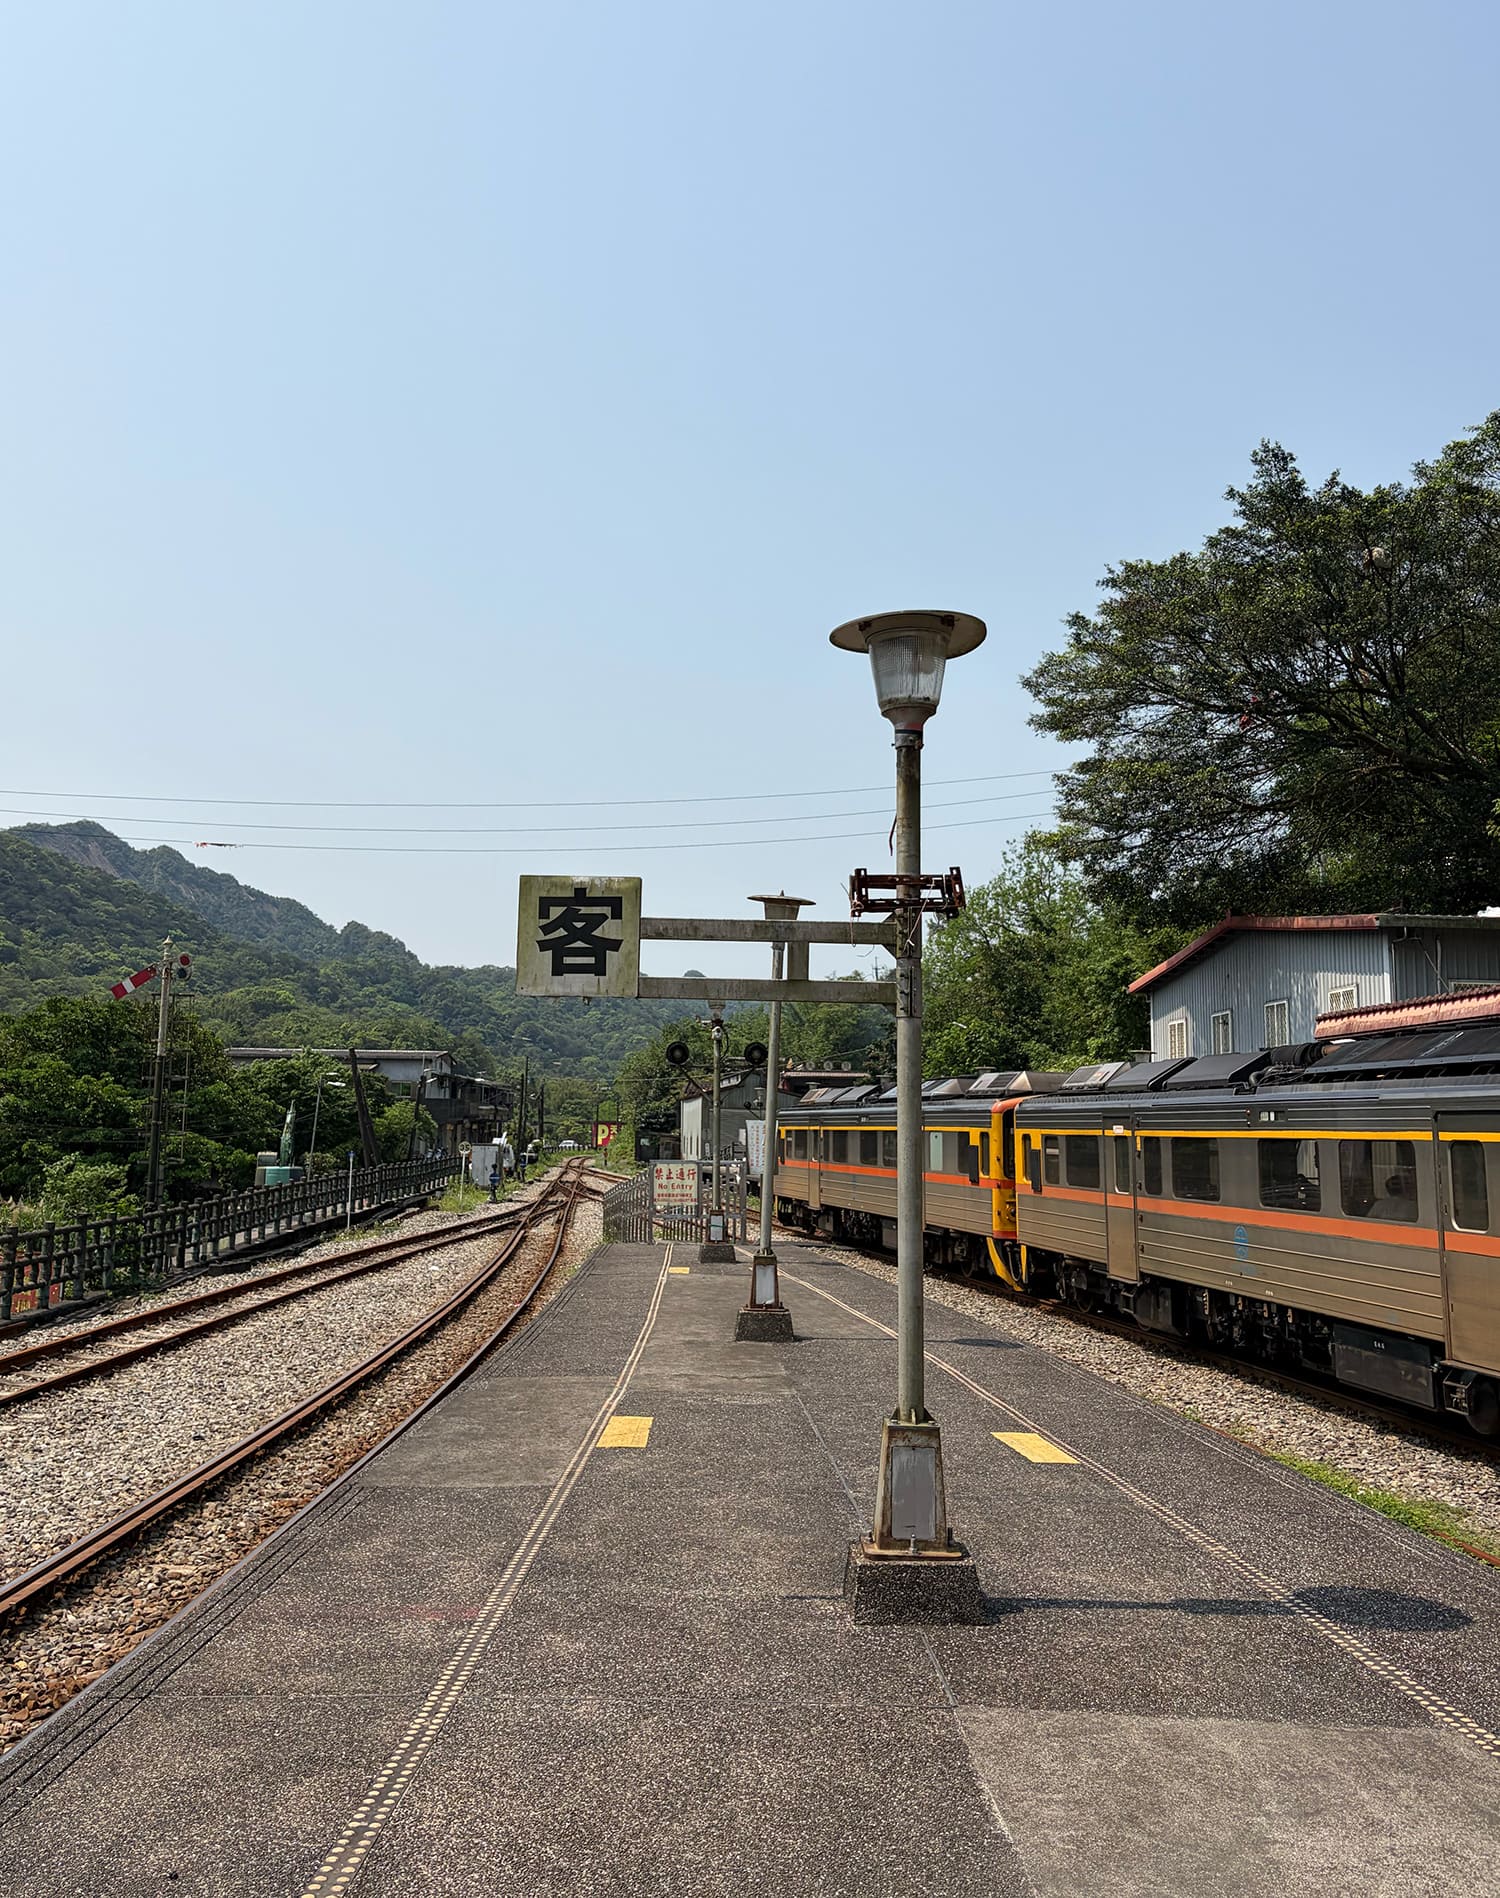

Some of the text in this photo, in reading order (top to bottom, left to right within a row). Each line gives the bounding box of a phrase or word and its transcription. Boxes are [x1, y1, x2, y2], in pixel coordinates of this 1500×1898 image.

[535, 888, 624, 976] 客
[597, 1124, 609, 1145] P
[655, 1167, 697, 1181] 禁止通行
